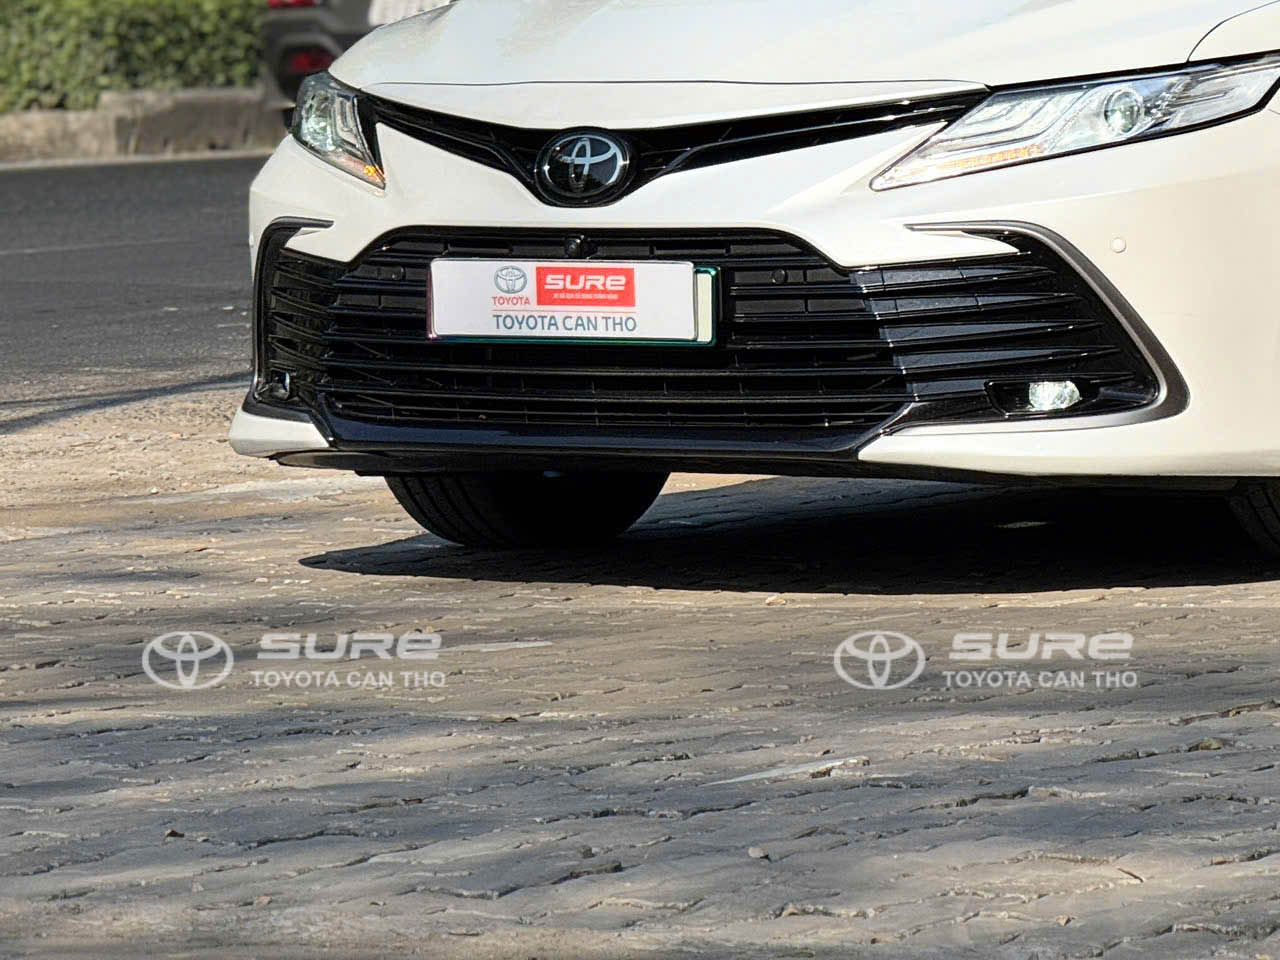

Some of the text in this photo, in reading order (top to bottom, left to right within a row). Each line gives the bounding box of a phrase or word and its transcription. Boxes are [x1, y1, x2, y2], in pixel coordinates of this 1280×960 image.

[492, 296, 531, 306] TOYOTA
[492, 314, 638, 332] TOYOTA CAN THO
